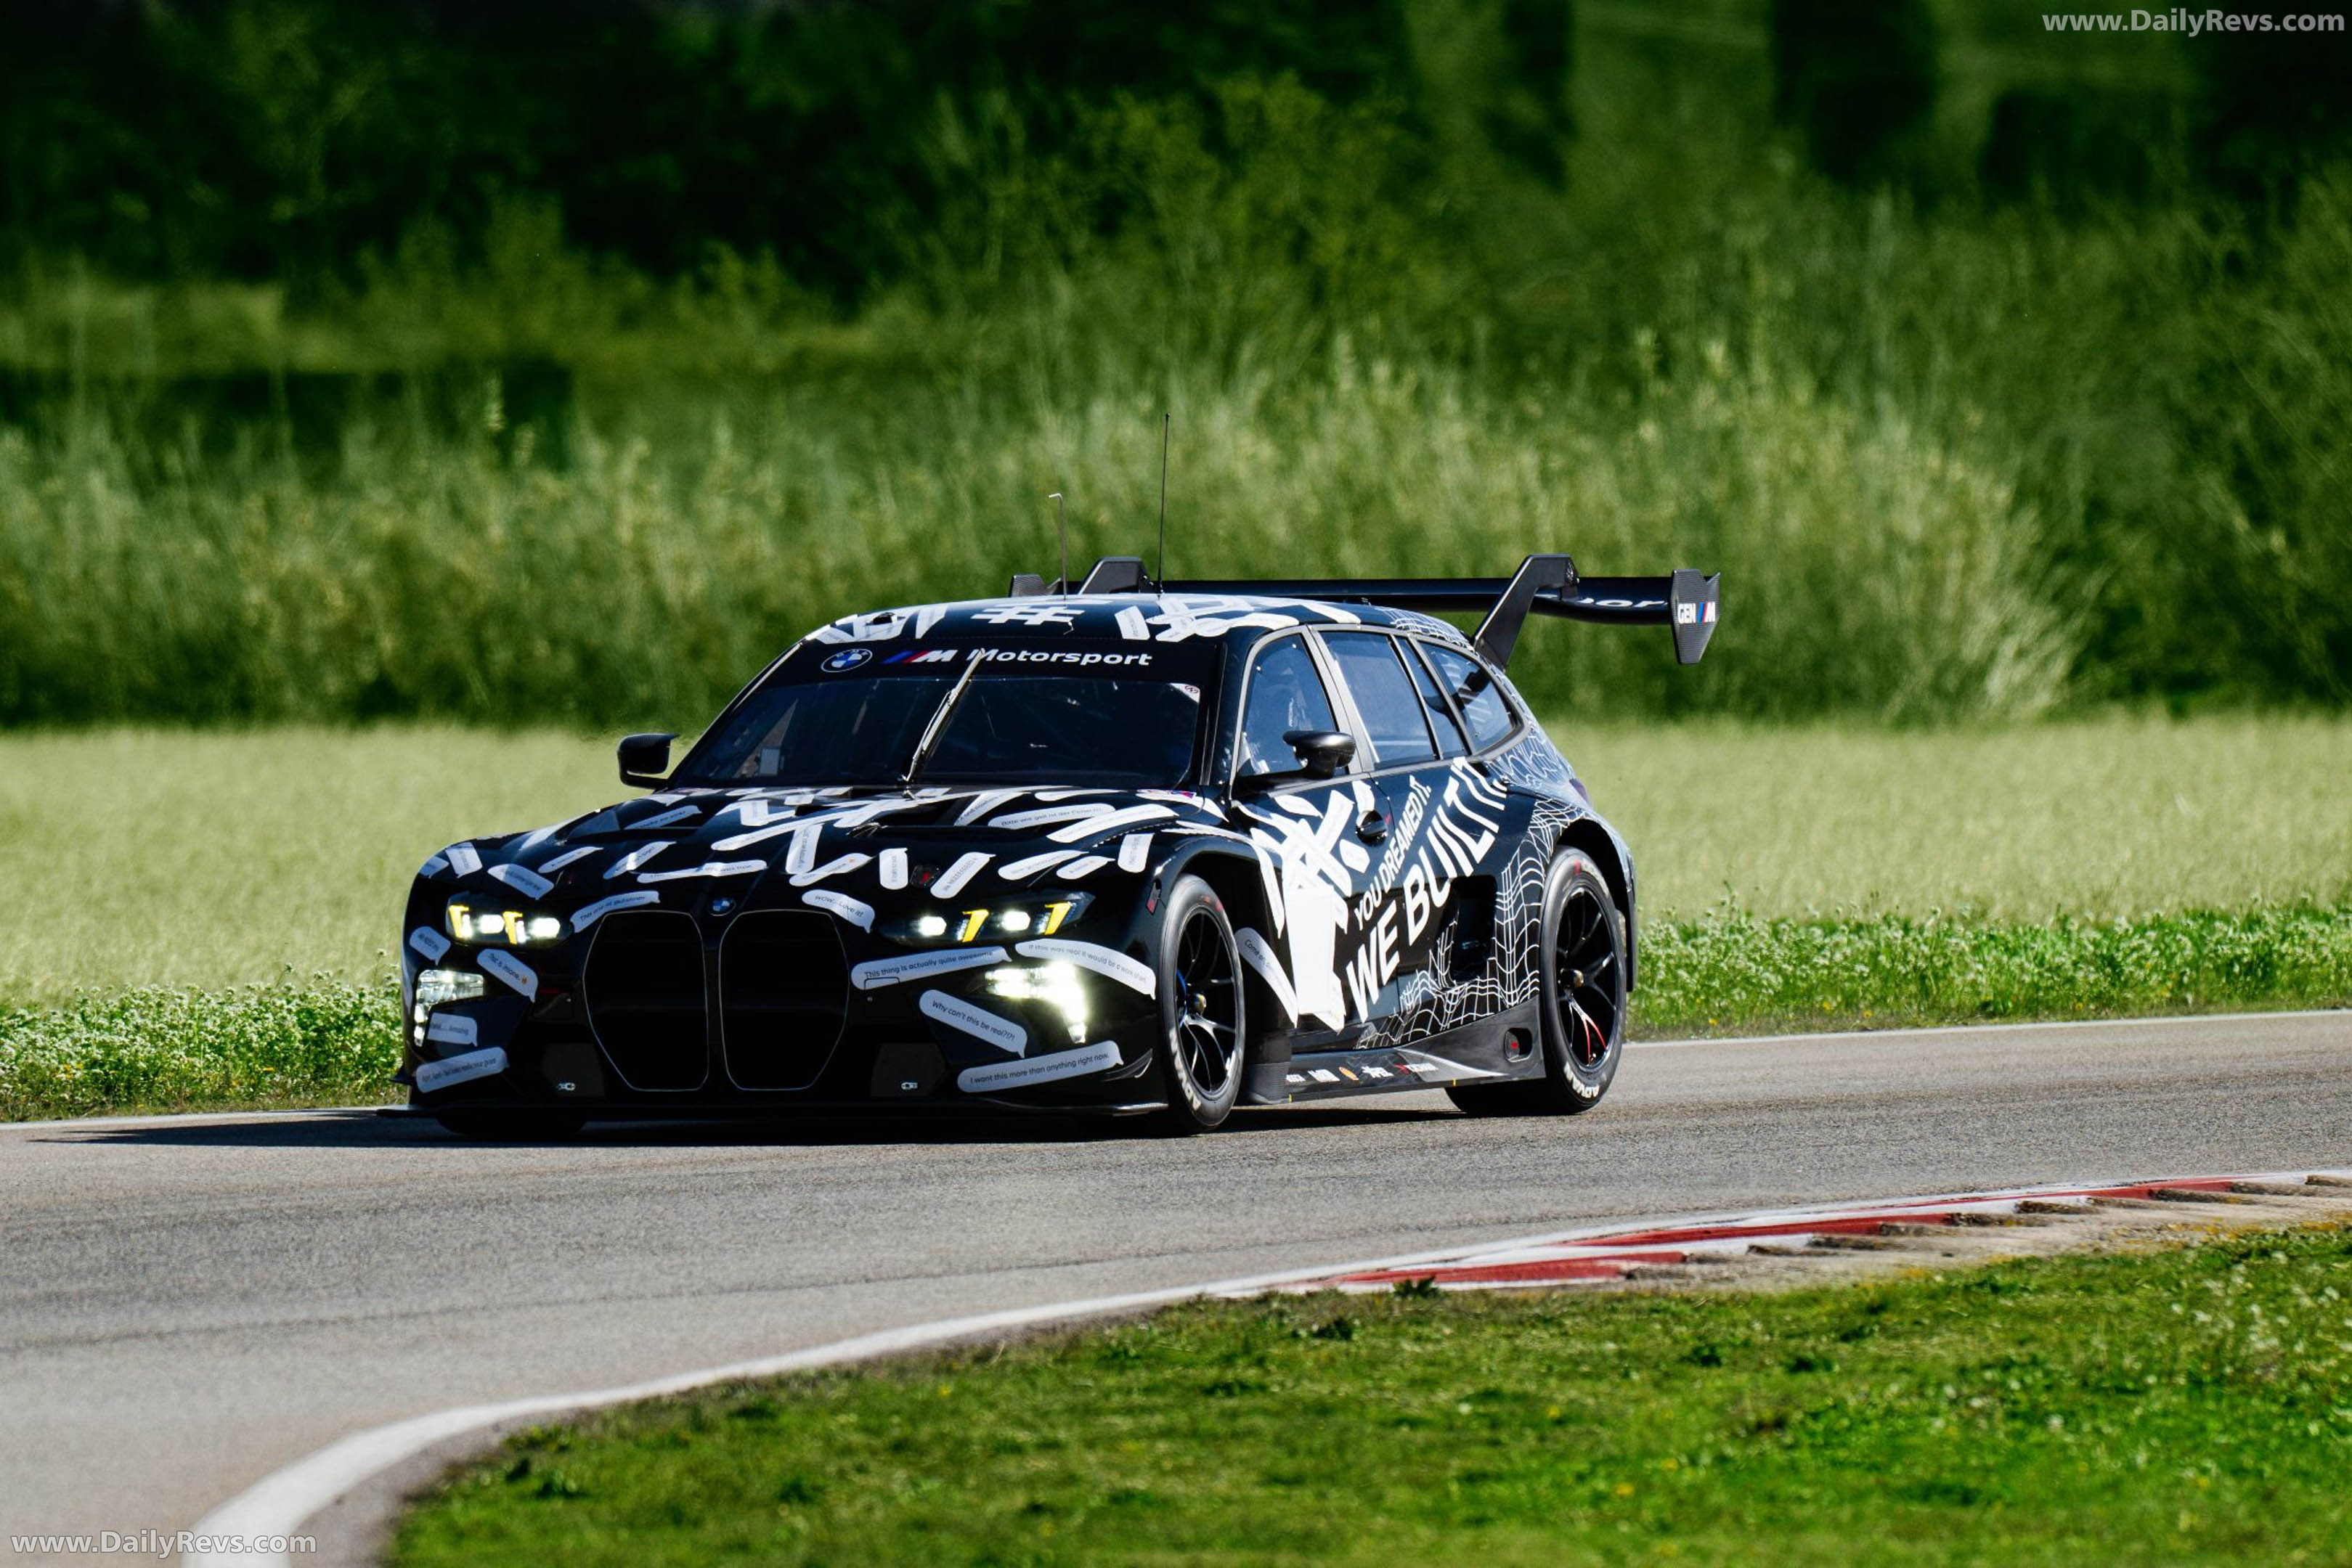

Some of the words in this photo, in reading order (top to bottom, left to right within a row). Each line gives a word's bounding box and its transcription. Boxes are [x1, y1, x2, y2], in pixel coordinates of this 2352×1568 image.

[967, 648, 1152, 666] Motorsport
[1354, 876, 1382, 931] YOU
[1378, 791, 1423, 894] DREAMED
[1346, 899, 1400, 1024] WE
[1403, 775, 1499, 947] BUILT
[881, 966, 900, 976] thing
[908, 959, 937, 970] actually
[938, 956, 956, 965] quite
[1088, 953, 1108, 964] would
[1108, 959, 1116, 968] be
[932, 1000, 948, 1013] Why
[948, 1008, 965, 1020] can't
[967, 1016, 980, 1026] this
[980, 1021, 990, 1031] be
[974, 1075, 993, 1084] want
[1009, 1070, 1028, 1079] more
[1029, 1066, 1046, 1076] than
[1046, 1060, 1078, 1072] anything
[1078, 1056, 1094, 1068] right
